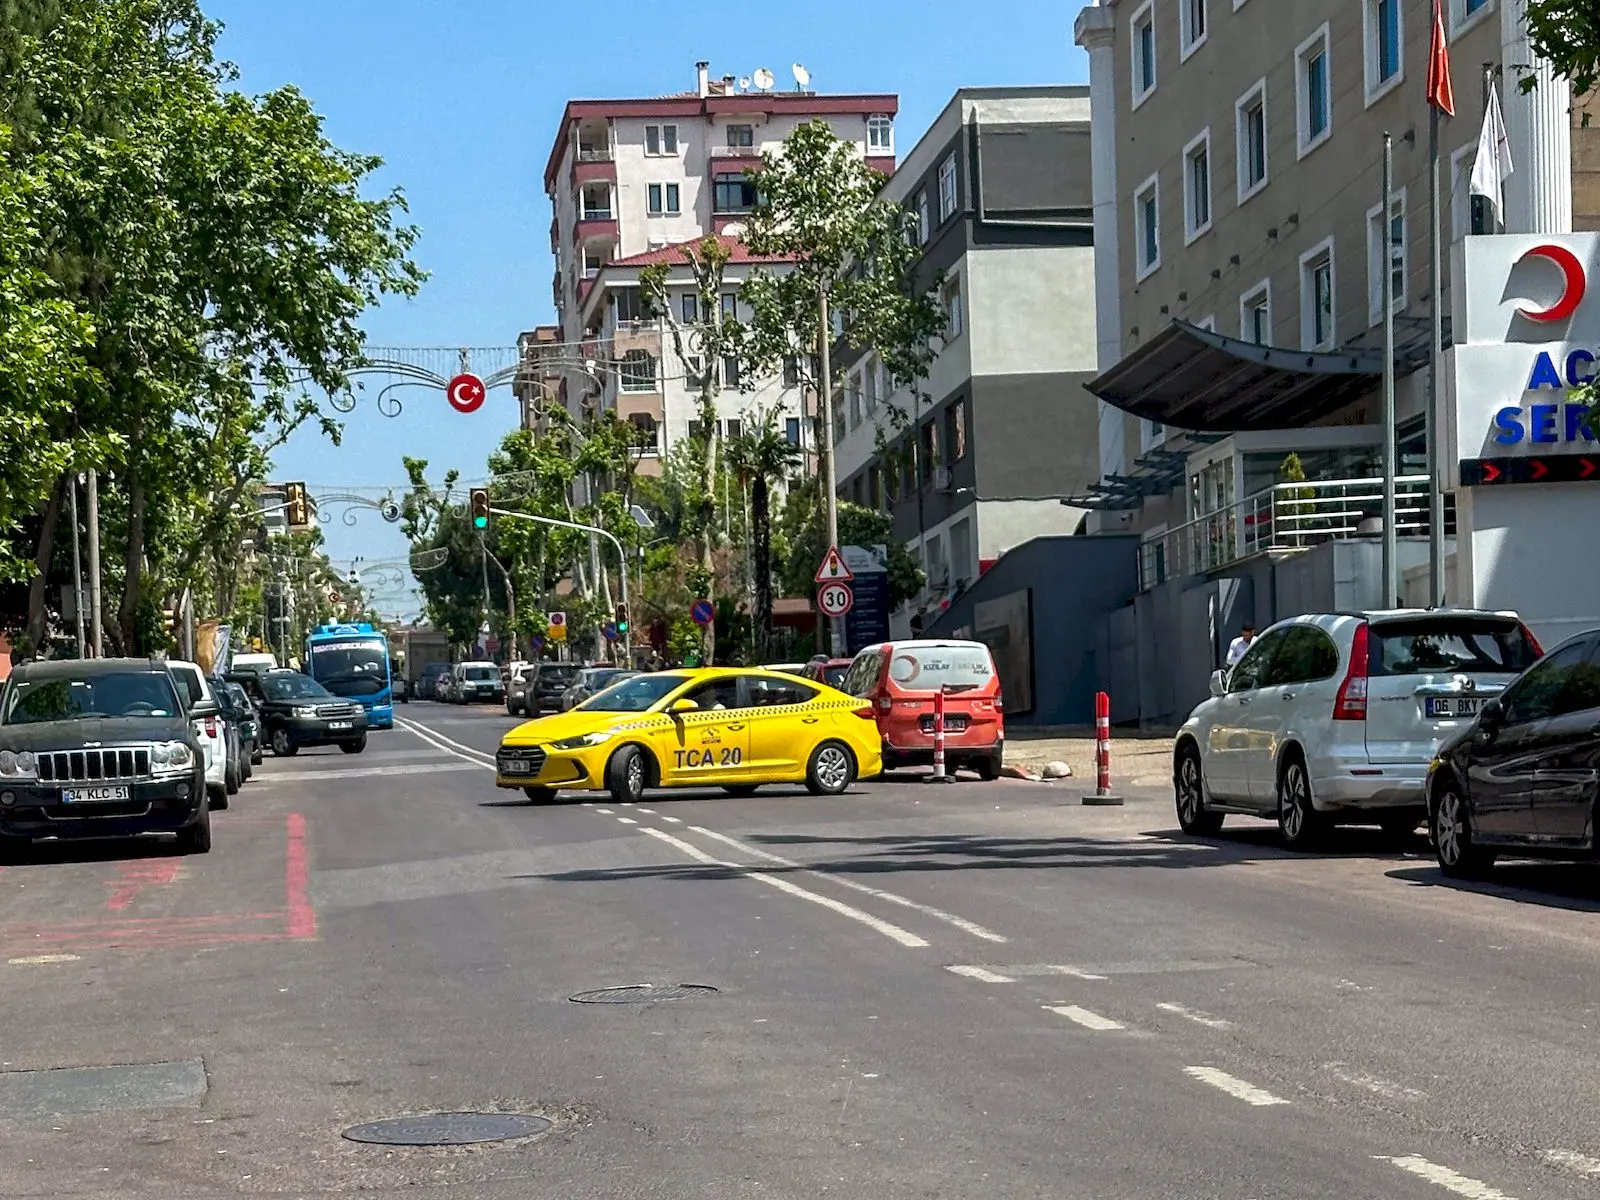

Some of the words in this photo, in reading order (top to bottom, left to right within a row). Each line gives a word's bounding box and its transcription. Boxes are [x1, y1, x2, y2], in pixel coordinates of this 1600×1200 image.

[826, 591, 846, 607] 30
[1434, 700, 1449, 712] 06
[1458, 699, 1478, 712] BKY
[674, 748, 715, 769] TCA
[720, 746, 742, 766] 20
[69, 788, 82, 800] 34
[87, 788, 110, 799] KLC
[115, 787, 127, 798] 51
